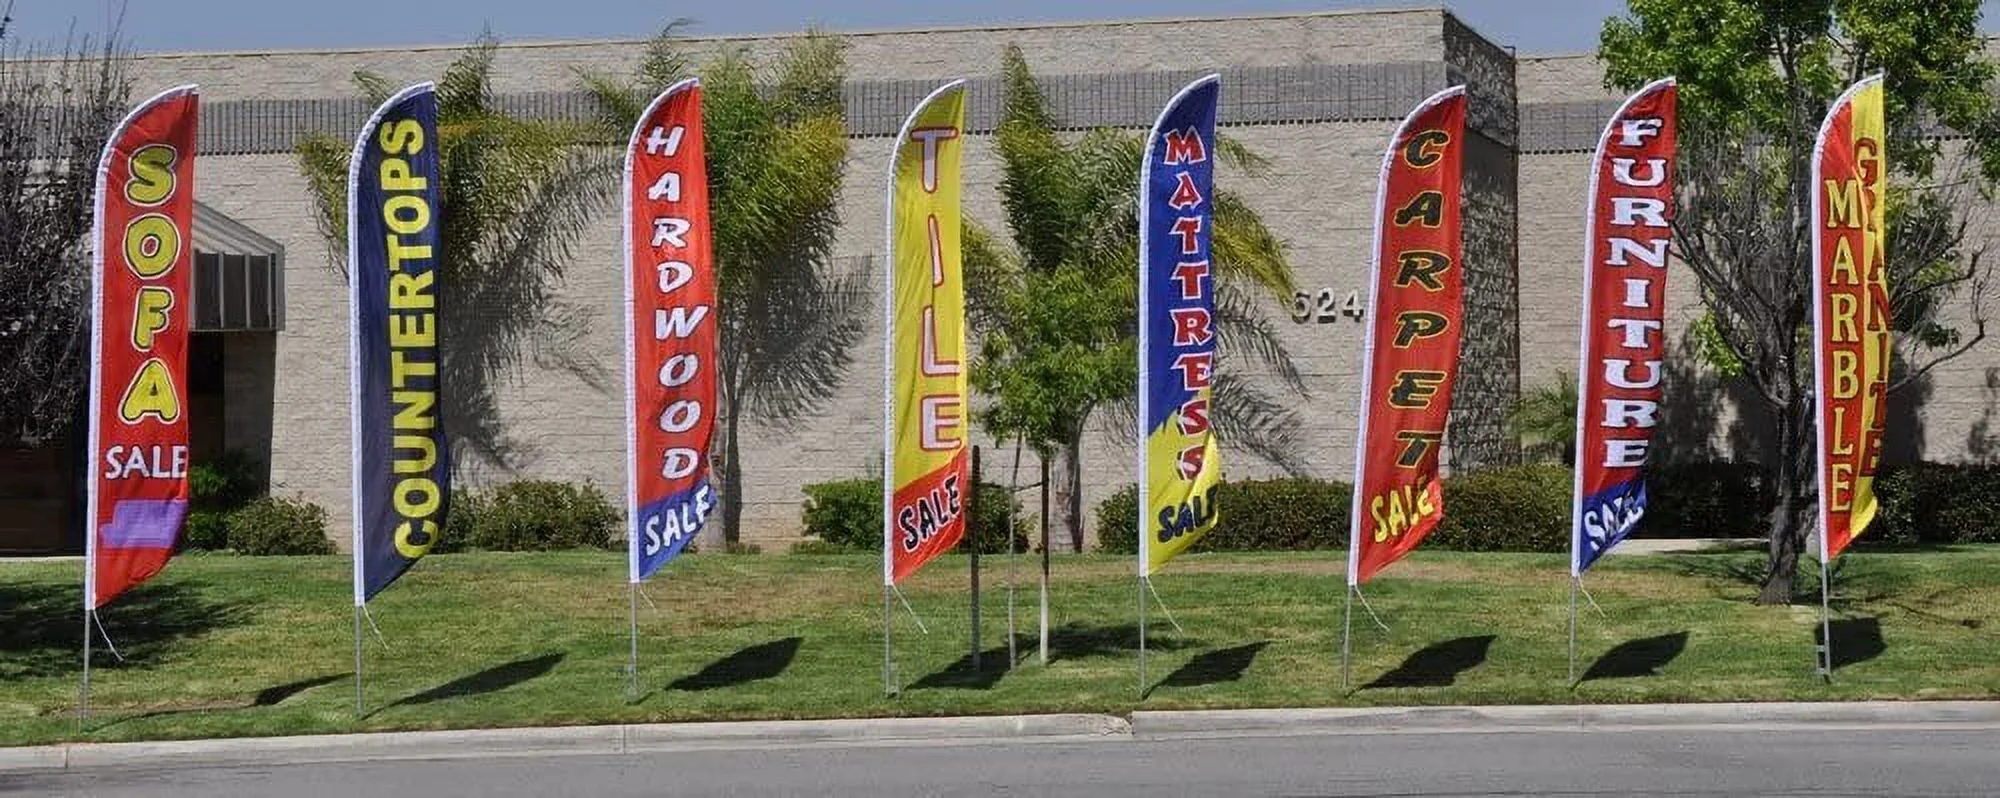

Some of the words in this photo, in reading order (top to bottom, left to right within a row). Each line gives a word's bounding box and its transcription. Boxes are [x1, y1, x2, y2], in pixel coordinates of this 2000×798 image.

[120, 144, 181, 424] SOFA
[380, 119, 439, 559] COUNTERTOPS
[646, 126, 708, 479] HARDWOOD
[911, 127, 961, 451] TILE
[1164, 131, 1213, 481] MATTRESS
[1388, 130, 1451, 469] CARPET
[1601, 119, 1670, 467] FURNITURE
[1824, 180, 1862, 514] MARBLE
[105, 445, 188, 479] SALE
[898, 475, 960, 552] SALE
